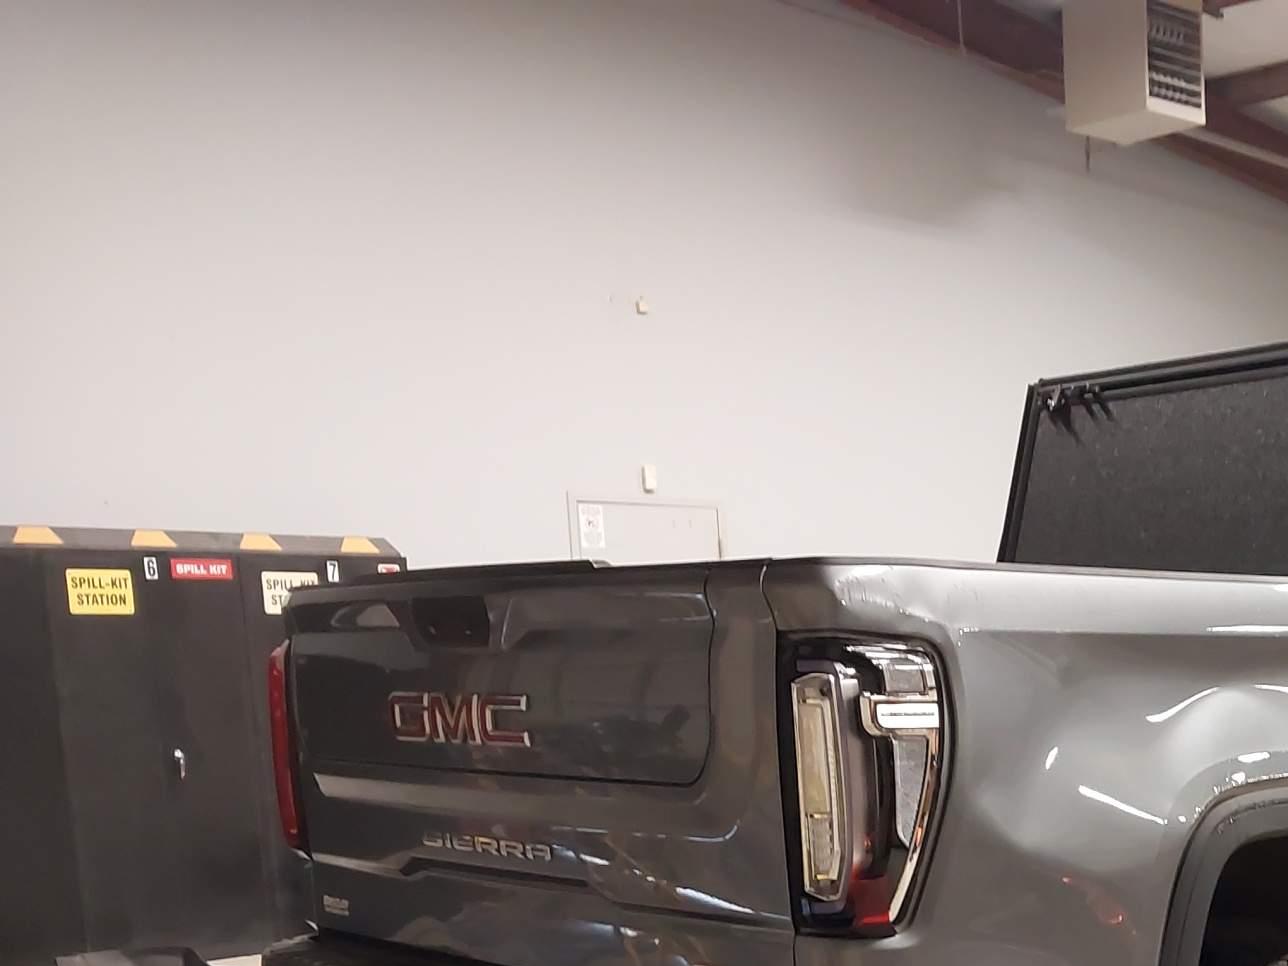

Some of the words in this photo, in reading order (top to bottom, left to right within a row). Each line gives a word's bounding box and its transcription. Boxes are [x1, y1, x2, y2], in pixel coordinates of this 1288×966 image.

[147, 559, 155, 577] 6
[175, 563, 207, 575] SPILL
[209, 563, 228, 575] KIT
[329, 562, 337, 581] 7
[70, 576, 129, 590] SPILL-KIT
[77, 593, 127, 606] STATION
[388, 690, 533, 749] GMC
[422, 832, 553, 862] SIERRA
